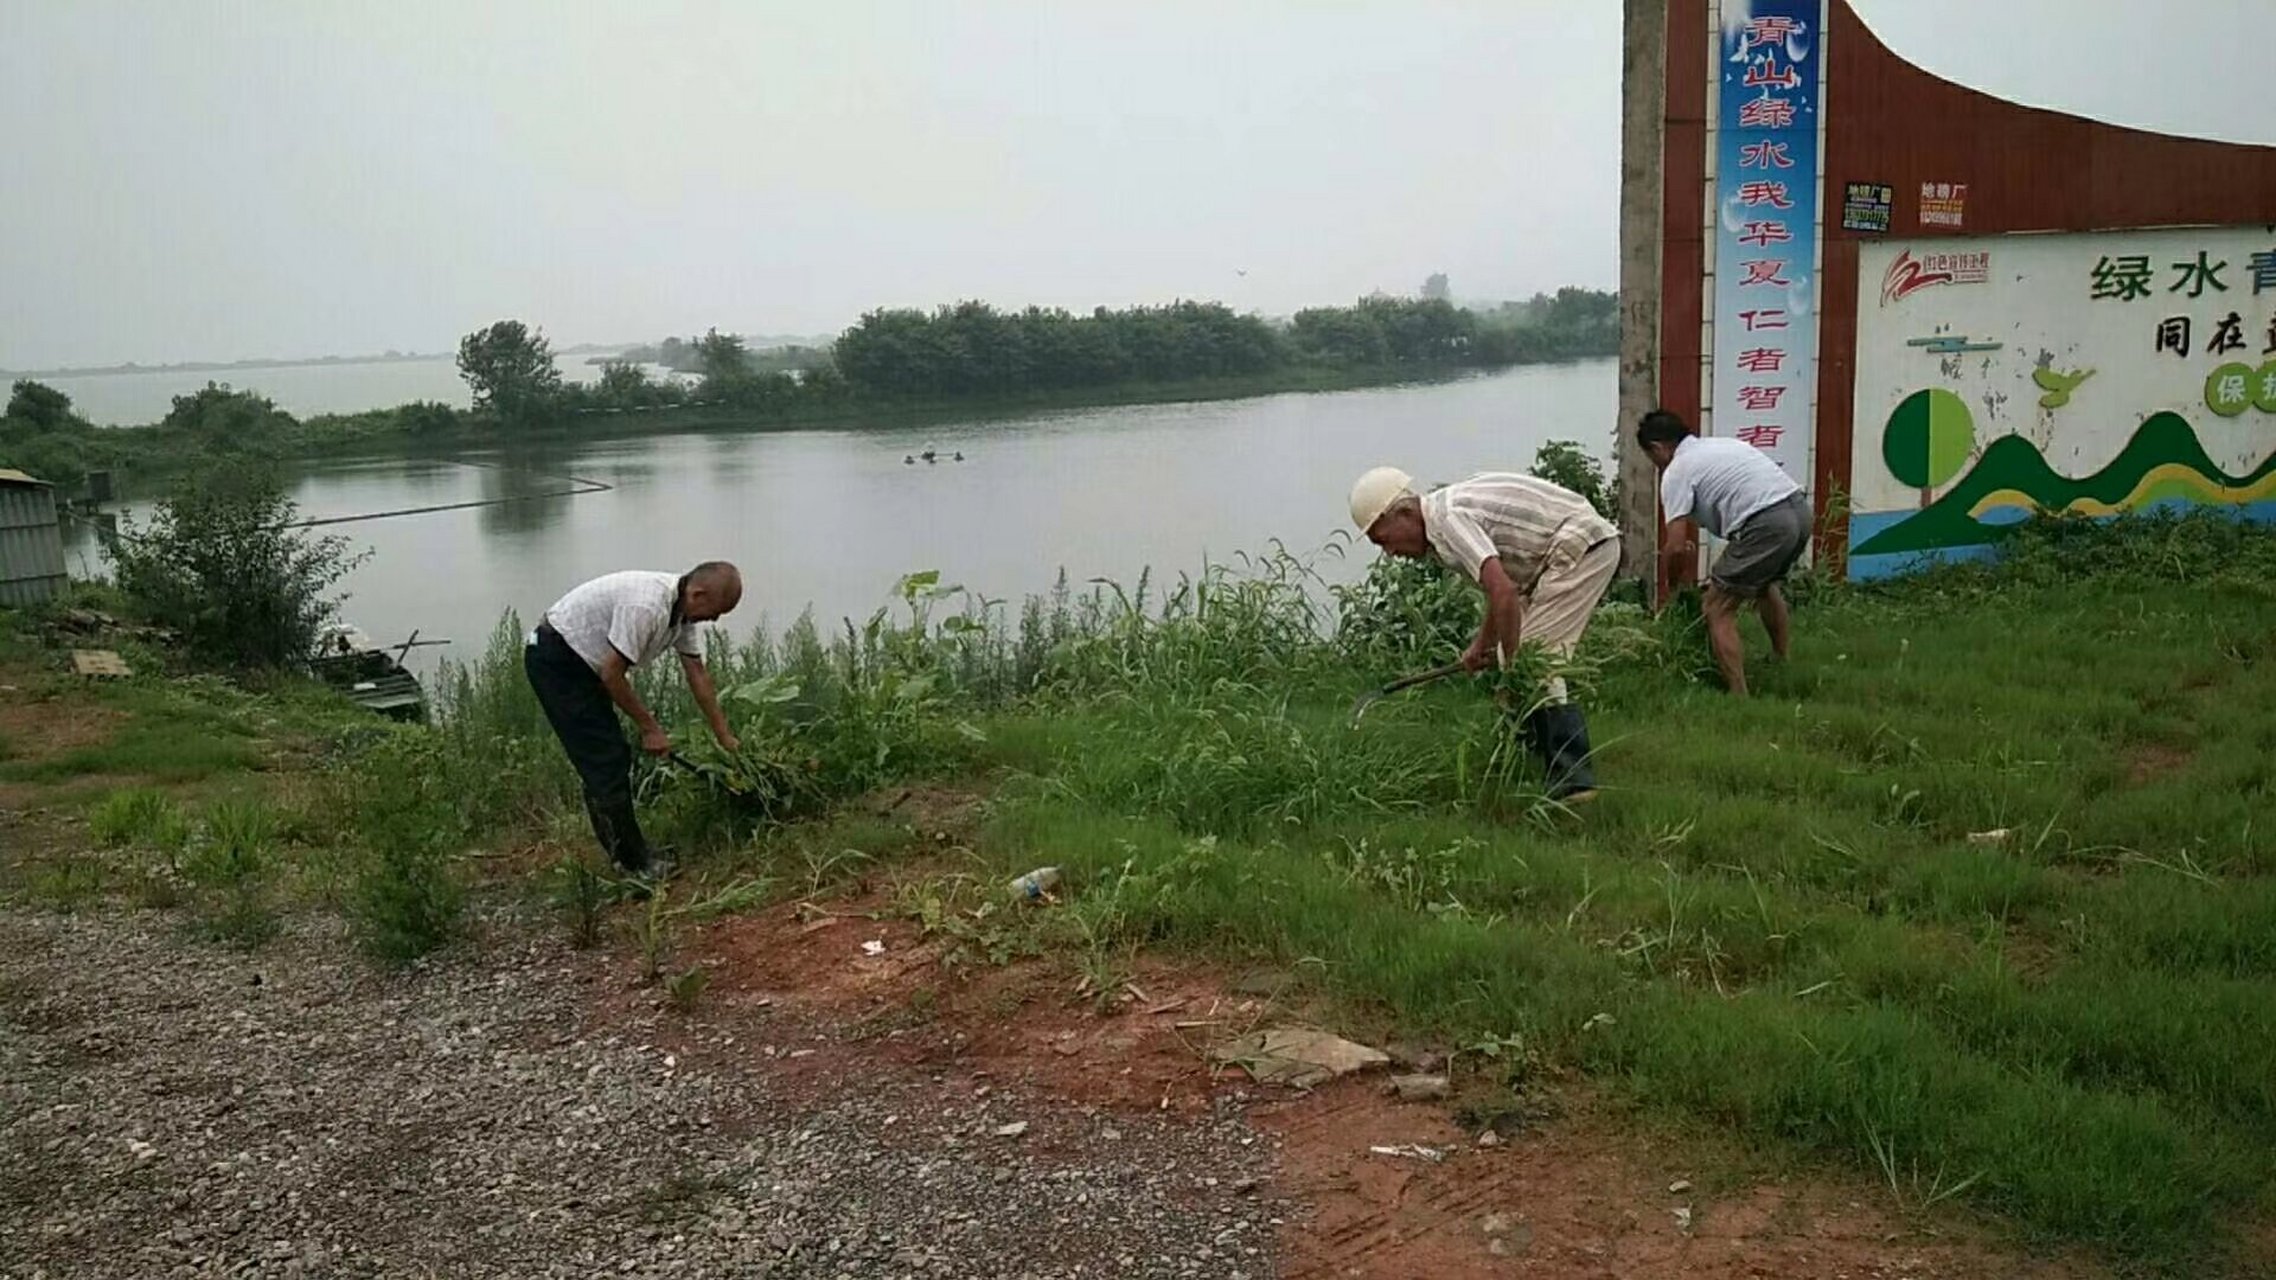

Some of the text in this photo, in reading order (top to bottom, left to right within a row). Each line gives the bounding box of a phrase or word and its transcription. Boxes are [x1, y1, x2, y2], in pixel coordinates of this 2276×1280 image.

[1737, 16, 1797, 466] 青山绿水我华夏仁者智者
